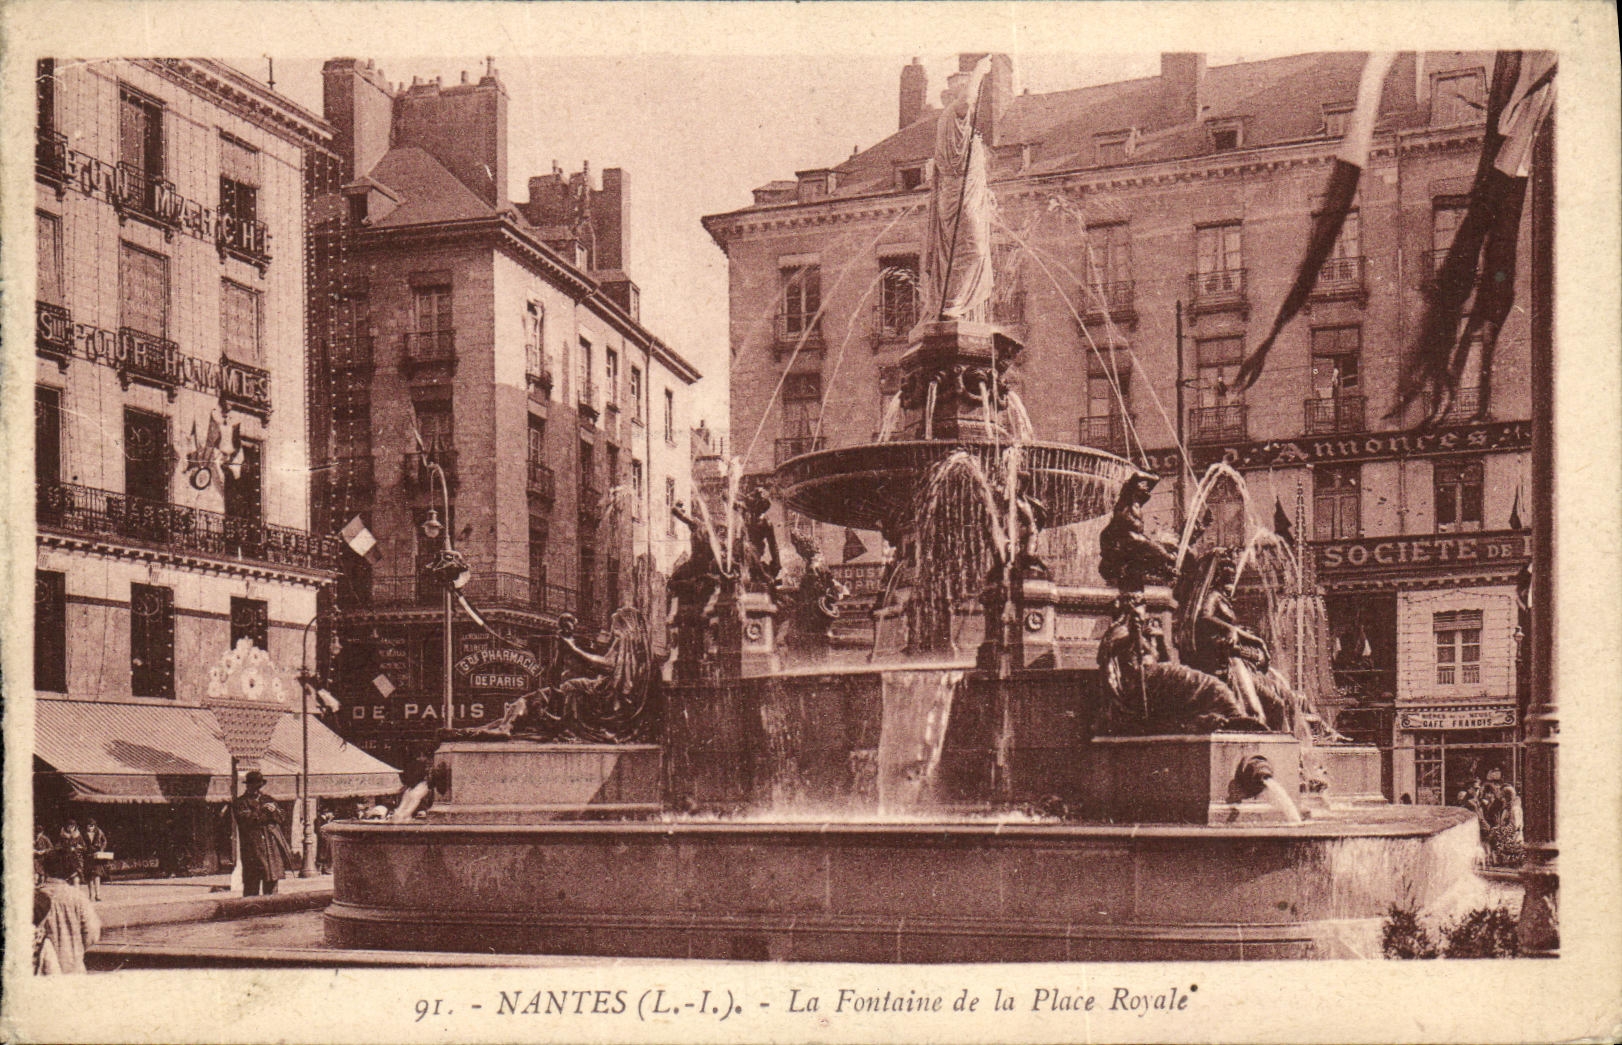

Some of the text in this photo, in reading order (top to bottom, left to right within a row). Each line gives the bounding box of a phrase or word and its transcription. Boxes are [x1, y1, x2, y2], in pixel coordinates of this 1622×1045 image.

[165, 348, 269, 401] HOMMES
[1487, 543, 1513, 558] DE
[481, 649, 540, 674] PHARMACIE
[475, 675, 525, 687] DE PARIS
[352, 705, 386, 720] DE
